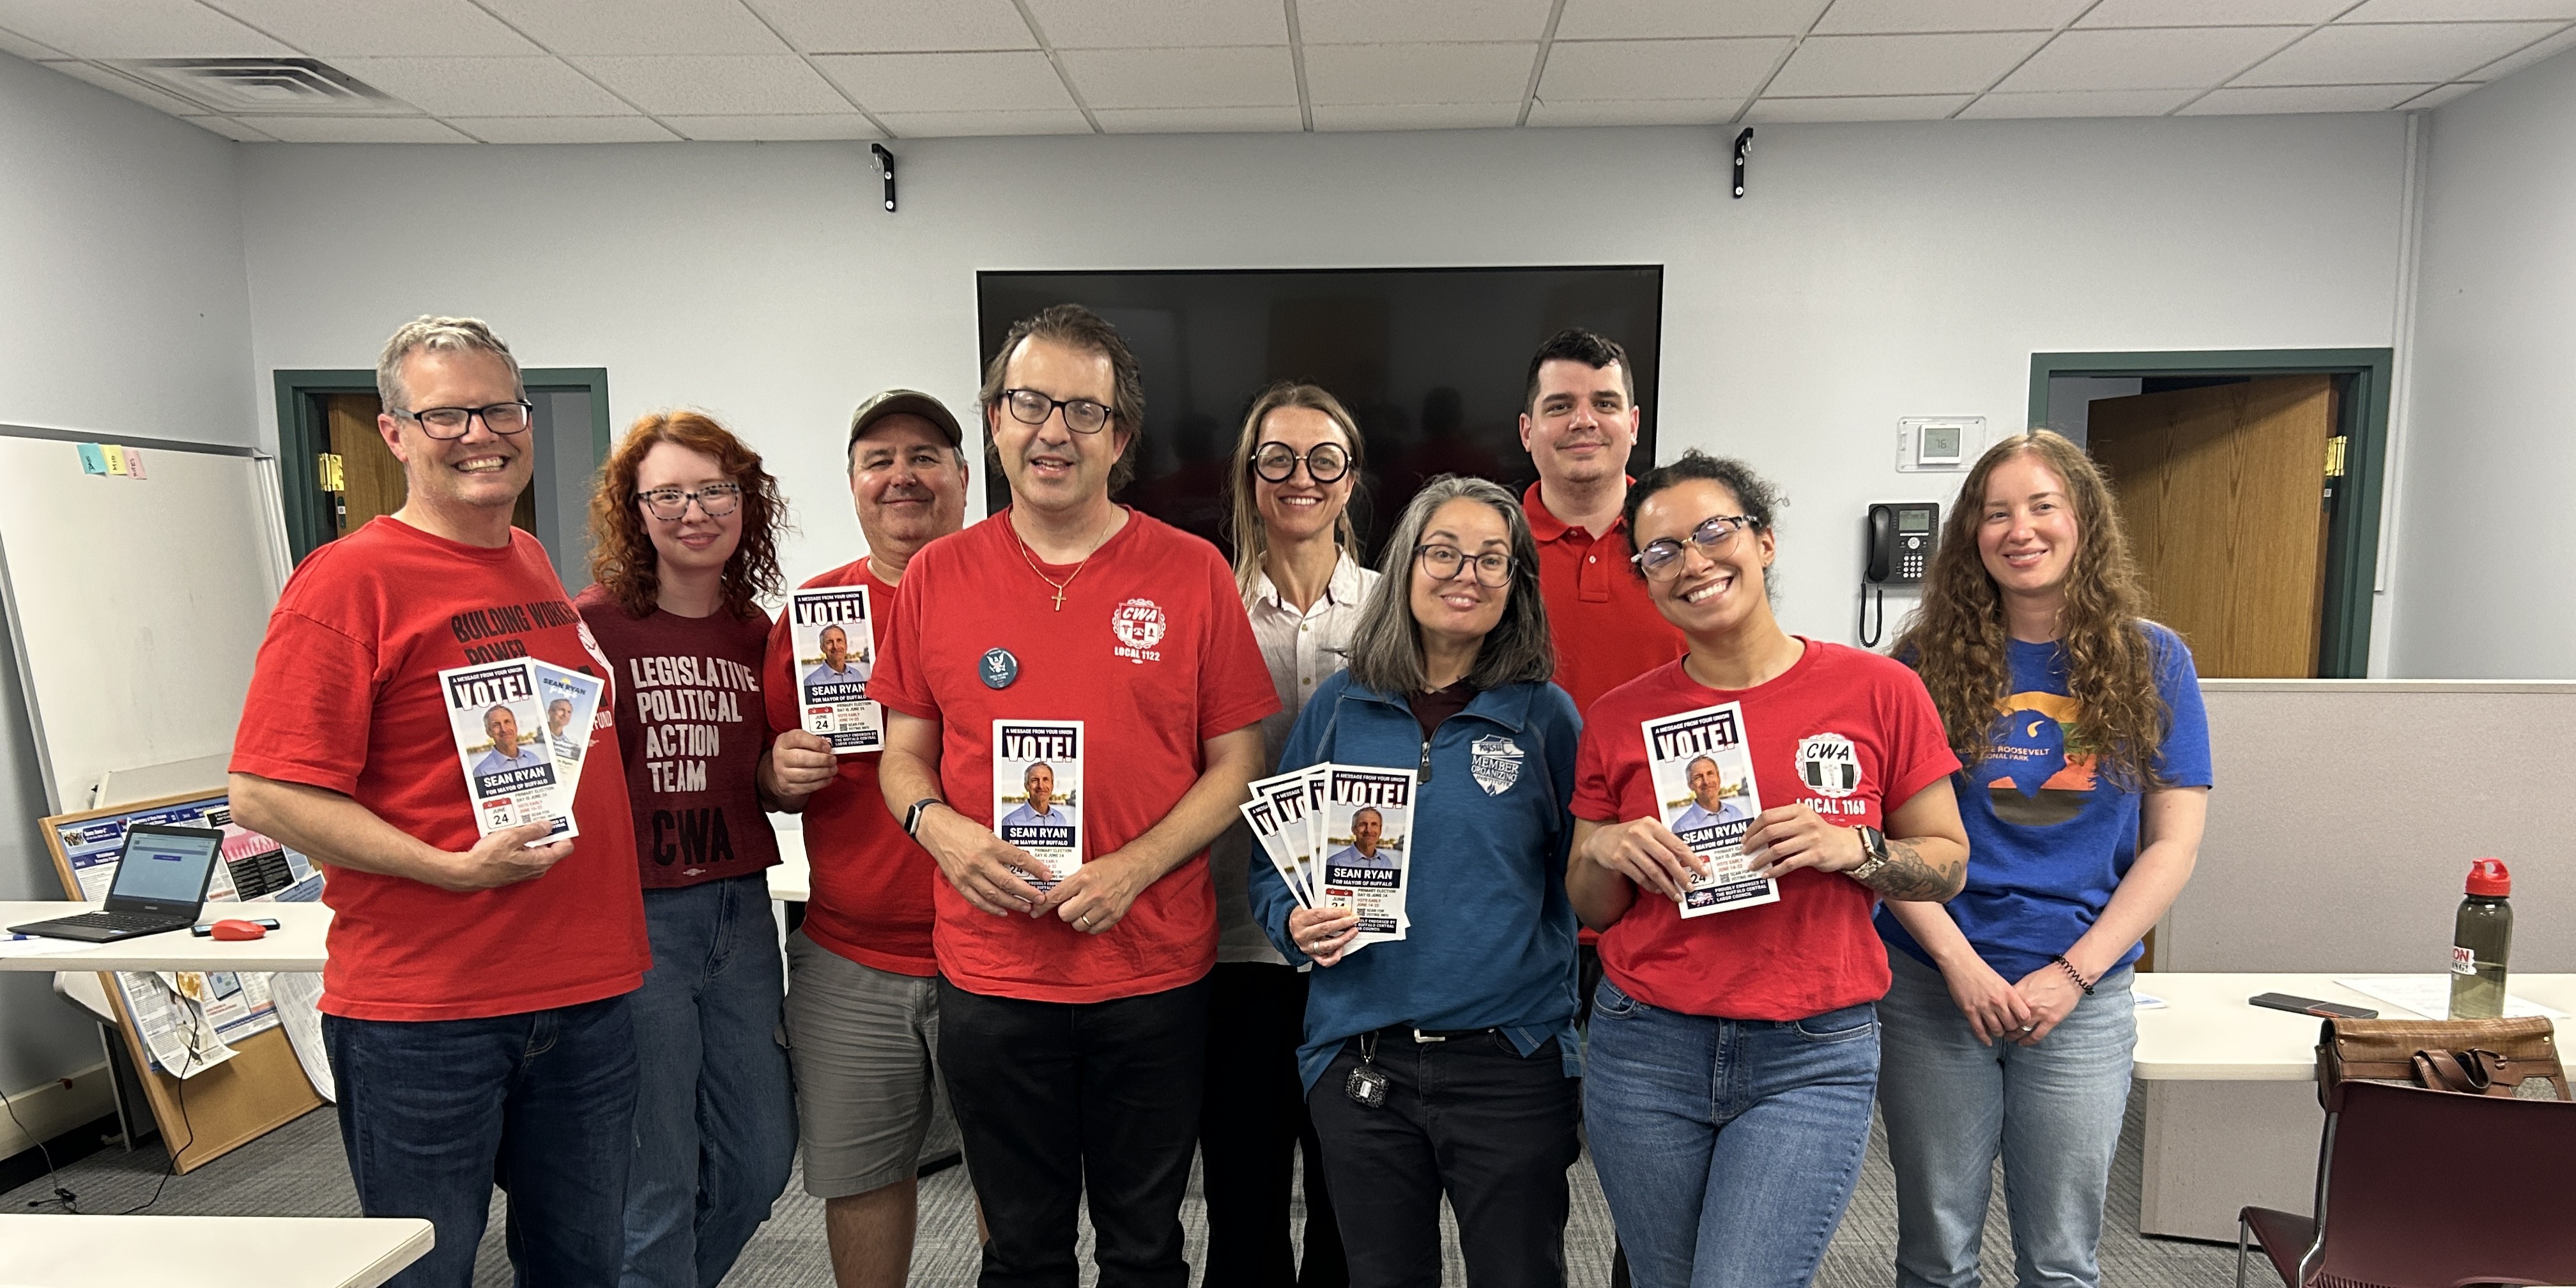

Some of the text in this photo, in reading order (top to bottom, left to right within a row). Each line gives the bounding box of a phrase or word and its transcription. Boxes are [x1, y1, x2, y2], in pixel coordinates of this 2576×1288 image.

[1935, 439, 1947, 449] 76
[799, 600, 861, 627] VOTE!
[1122, 607, 1158, 622] CWA
[451, 605, 532, 643] BUILDING
[1114, 646, 1140, 659] LOCAL
[1142, 650, 1160, 661] 1122
[630, 656, 760, 692] LEGISLATIVE
[454, 674, 529, 711] VOTE!
[544, 678, 564, 689] SEAN
[565, 685, 586, 695] RYAN
[812, 684, 865, 696] SEAN RYAN
[636, 689, 742, 724] POLITICAL
[594, 710, 613, 730] FUND
[816, 721, 829, 729] 24
[1660, 723, 1683, 732] MESSAGE
[647, 724, 719, 758] ACTION
[1006, 735, 1072, 762] VOTE!
[1657, 721, 1735, 763] VOTE!
[1807, 743, 1849, 761] CWA
[1997, 746, 2050, 756] ROOSEVELT
[1472, 755, 1519, 774] MEMBER
[484, 767, 545, 787] SEAN RYAN
[647, 760, 707, 793] TEAM
[1280, 789, 1300, 798] MESSAGE
[1337, 780, 1404, 809] VOTE!
[1842, 800, 1866, 815] 1168
[494, 814, 509, 825] 24
[652, 807, 735, 866] CWA
[1010, 828, 1067, 838] SEAN RYAN
[1683, 822, 1747, 844] SEAN RYAN
[1696, 842, 1716, 850] MAYOR
[1010, 865, 1023, 873] 24
[1334, 868, 1393, 879] SEAN RYAN
[1690, 874, 1706, 884] 24
